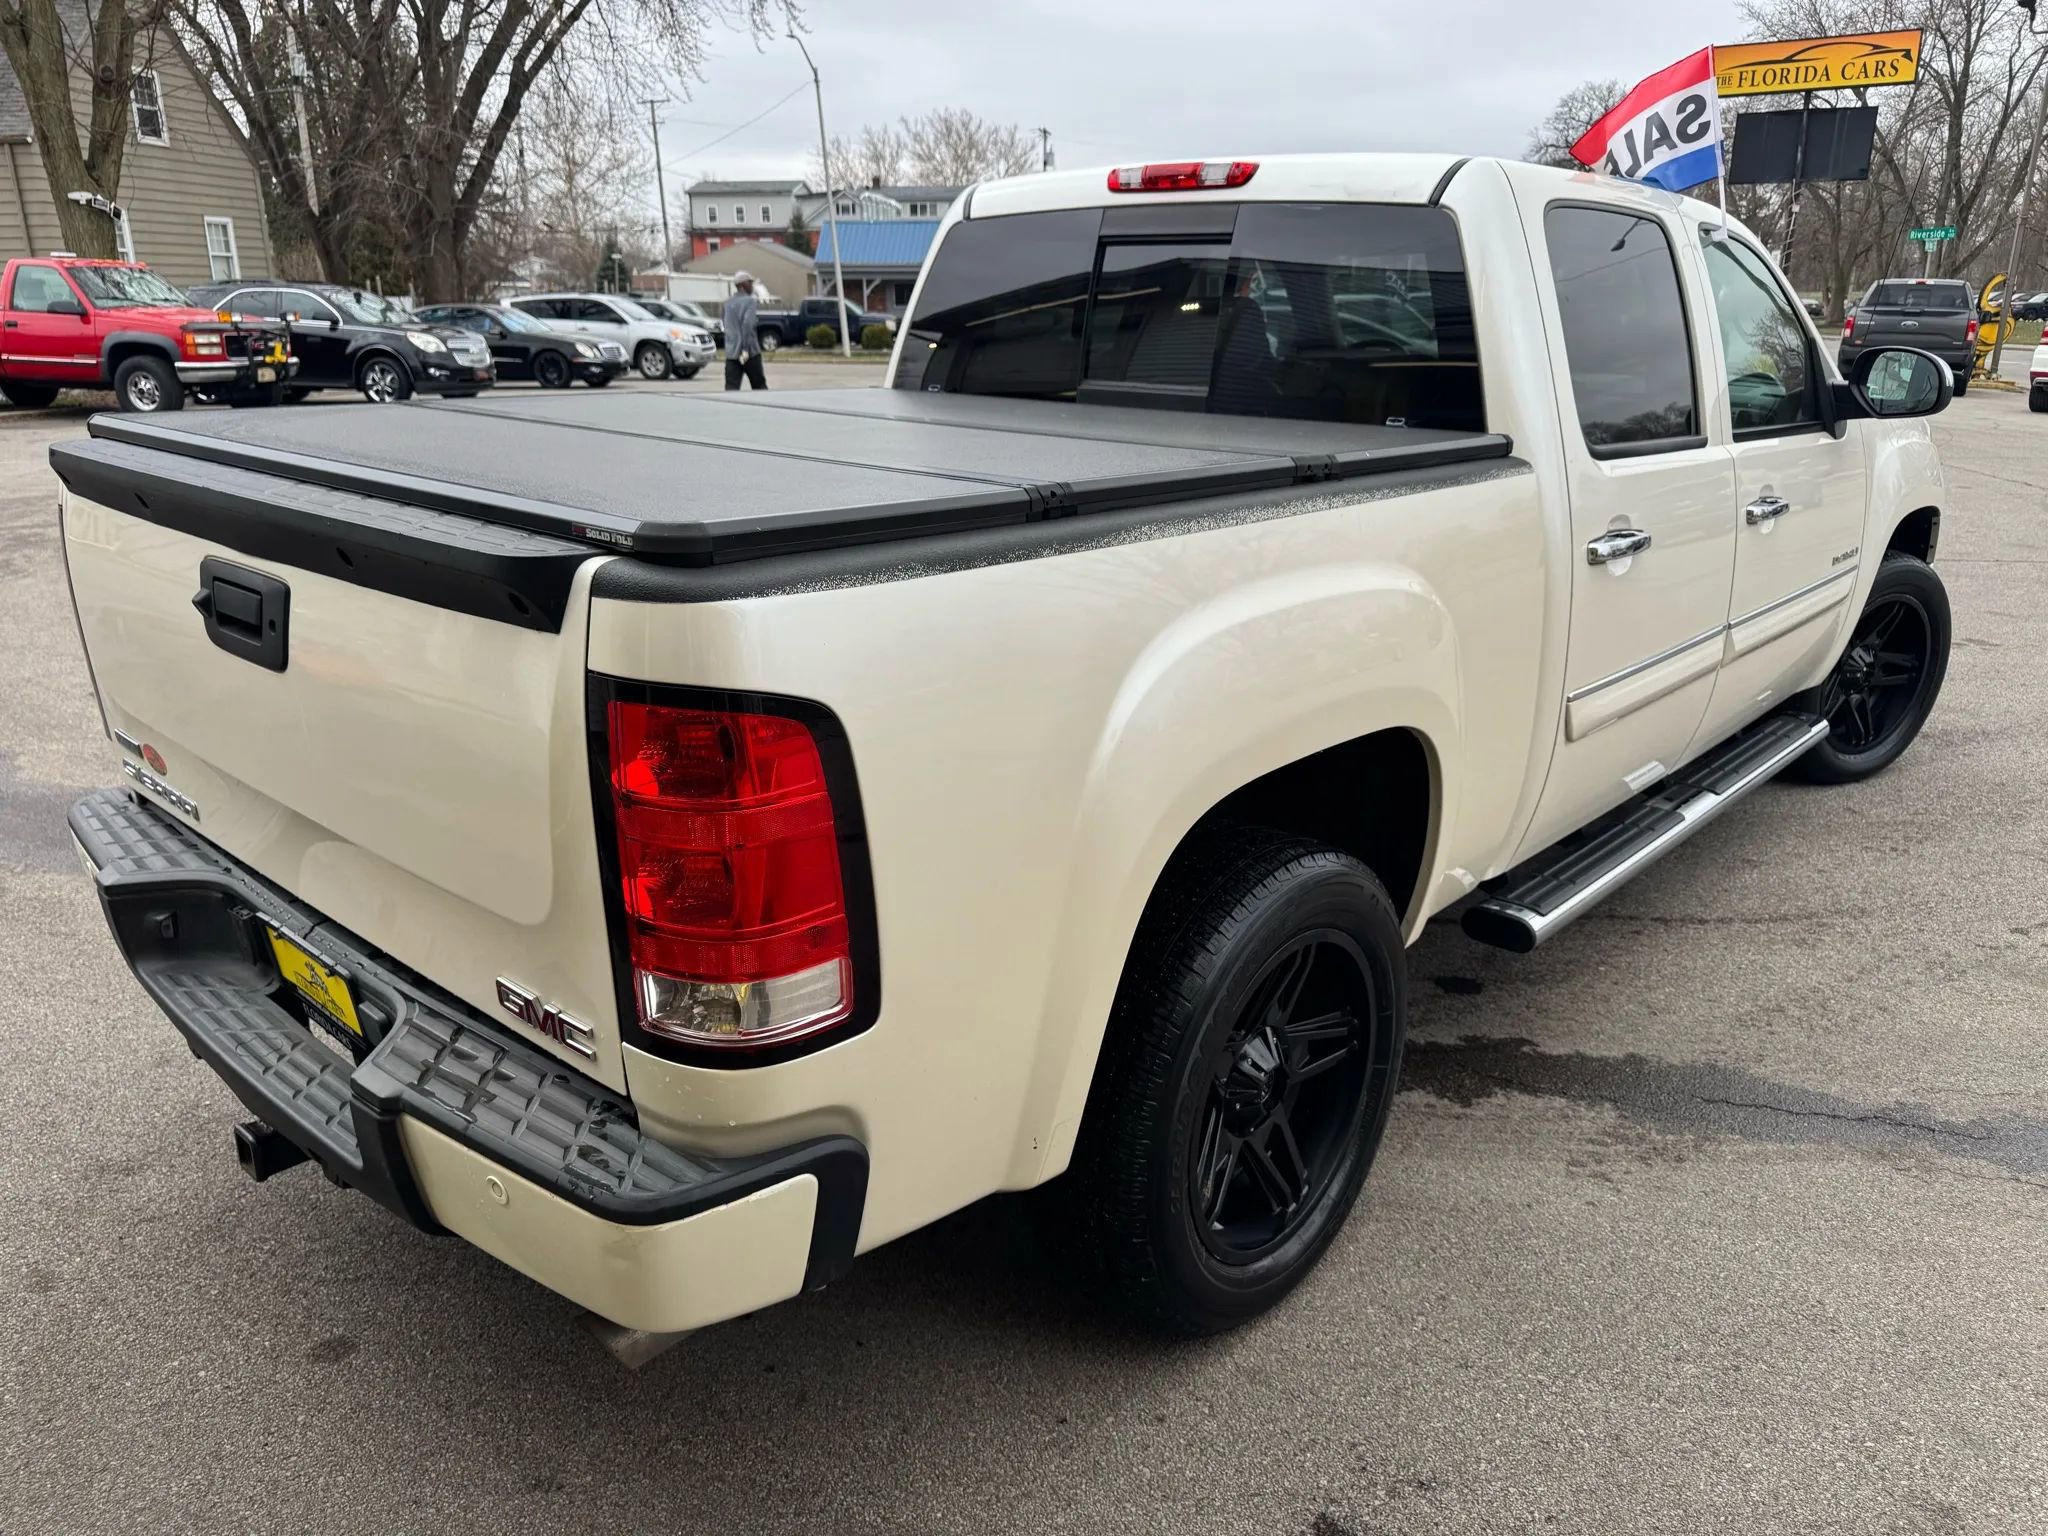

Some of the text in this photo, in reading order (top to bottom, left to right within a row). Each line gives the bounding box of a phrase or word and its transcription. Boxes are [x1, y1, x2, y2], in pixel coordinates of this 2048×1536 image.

[1716, 58, 1900, 88] THE FLORIDA CARS
[1910, 230, 1946, 240] Riverside
[122, 756, 201, 823] SIERRA
[495, 976, 598, 1063] GMC
